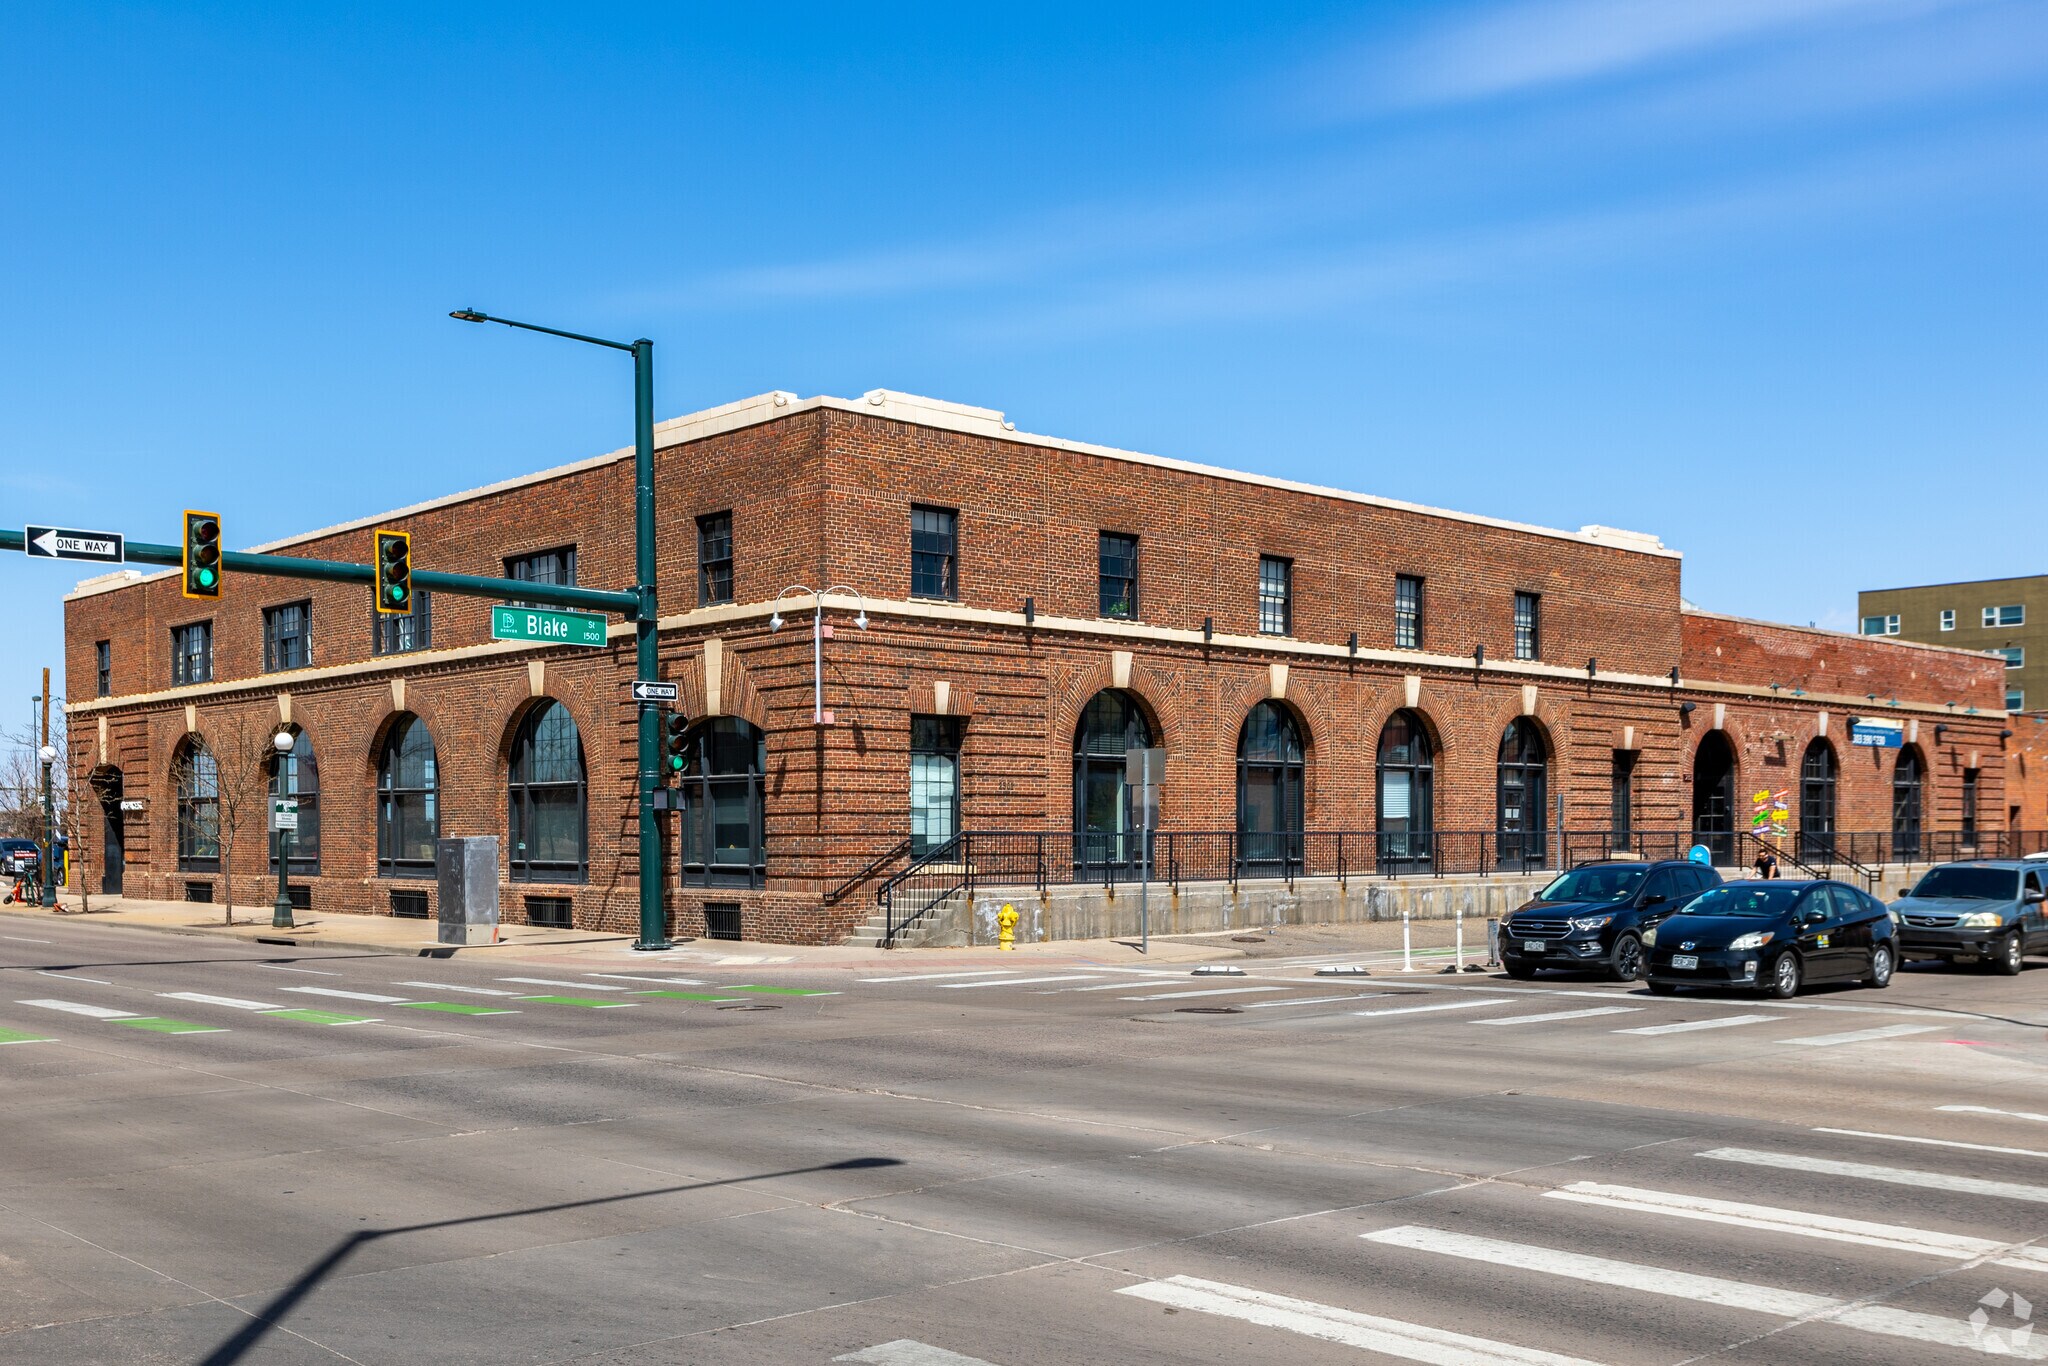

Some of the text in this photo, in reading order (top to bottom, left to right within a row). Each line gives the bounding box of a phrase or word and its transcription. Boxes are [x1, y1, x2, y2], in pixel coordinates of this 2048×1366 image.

[56, 538, 108, 552] ONE WAY
[527, 614, 568, 637] Blake
[588, 620, 596, 629] St
[583, 632, 600, 641] 1500
[646, 687, 659, 695] ONE
